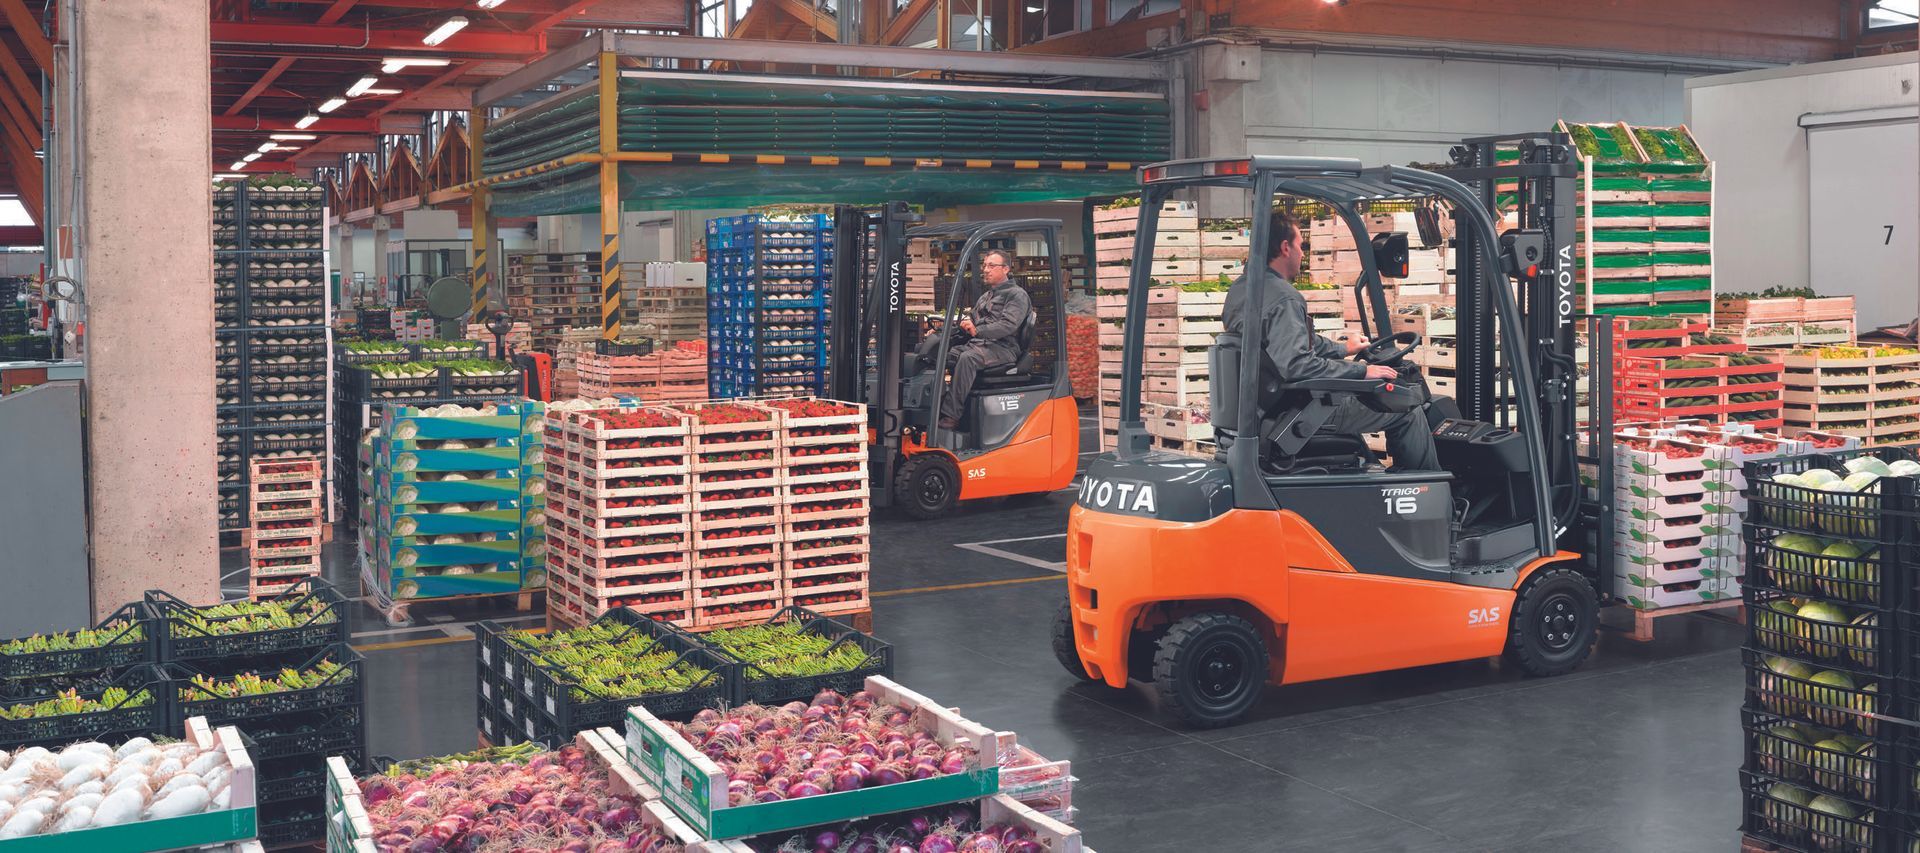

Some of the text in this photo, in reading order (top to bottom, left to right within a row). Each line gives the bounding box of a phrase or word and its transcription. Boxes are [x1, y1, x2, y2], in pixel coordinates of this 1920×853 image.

[1883, 225, 1894, 246] 7
[889, 261, 900, 313] TOYOTA
[1559, 244, 1571, 328] TOYOTA
[1000, 400, 1019, 411] 15
[968, 467, 986, 478] SAS
[1079, 475, 1155, 512] OYOTA
[1384, 496, 1417, 515] 16
[1468, 607, 1500, 625] SAS
